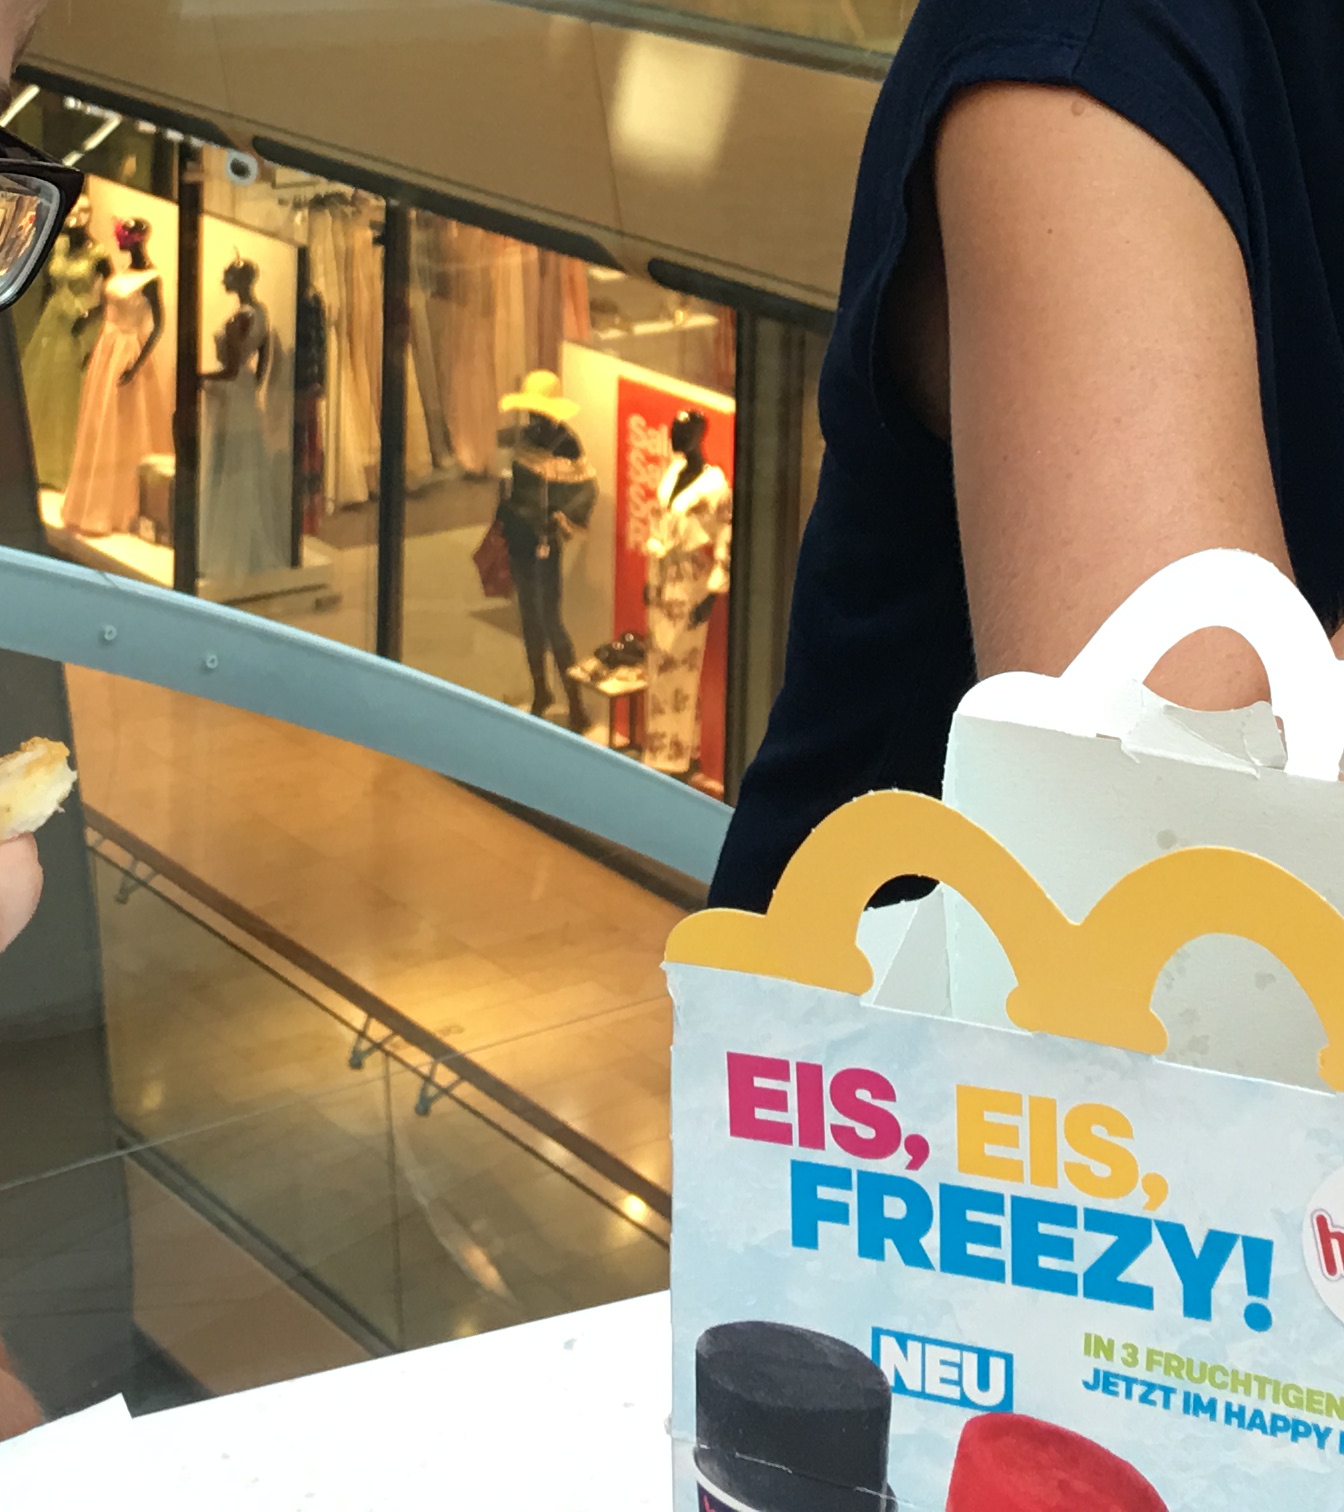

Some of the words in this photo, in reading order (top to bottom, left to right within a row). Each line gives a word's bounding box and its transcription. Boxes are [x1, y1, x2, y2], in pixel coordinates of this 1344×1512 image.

[726, 1052, 929, 1170] EIS,
[956, 1084, 1169, 1211] EIS,
[790, 1159, 1274, 1332] FREEZY!
[879, 1334, 1006, 1407] NEU
[1084, 1332, 1115, 1361] IN
[1121, 1342, 1139, 1368] 3
[1081, 1367, 1178, 1410] JETZT
[1183, 1390, 1218, 1422] IM
[1224, 1400, 1333, 1450] HAPPY
